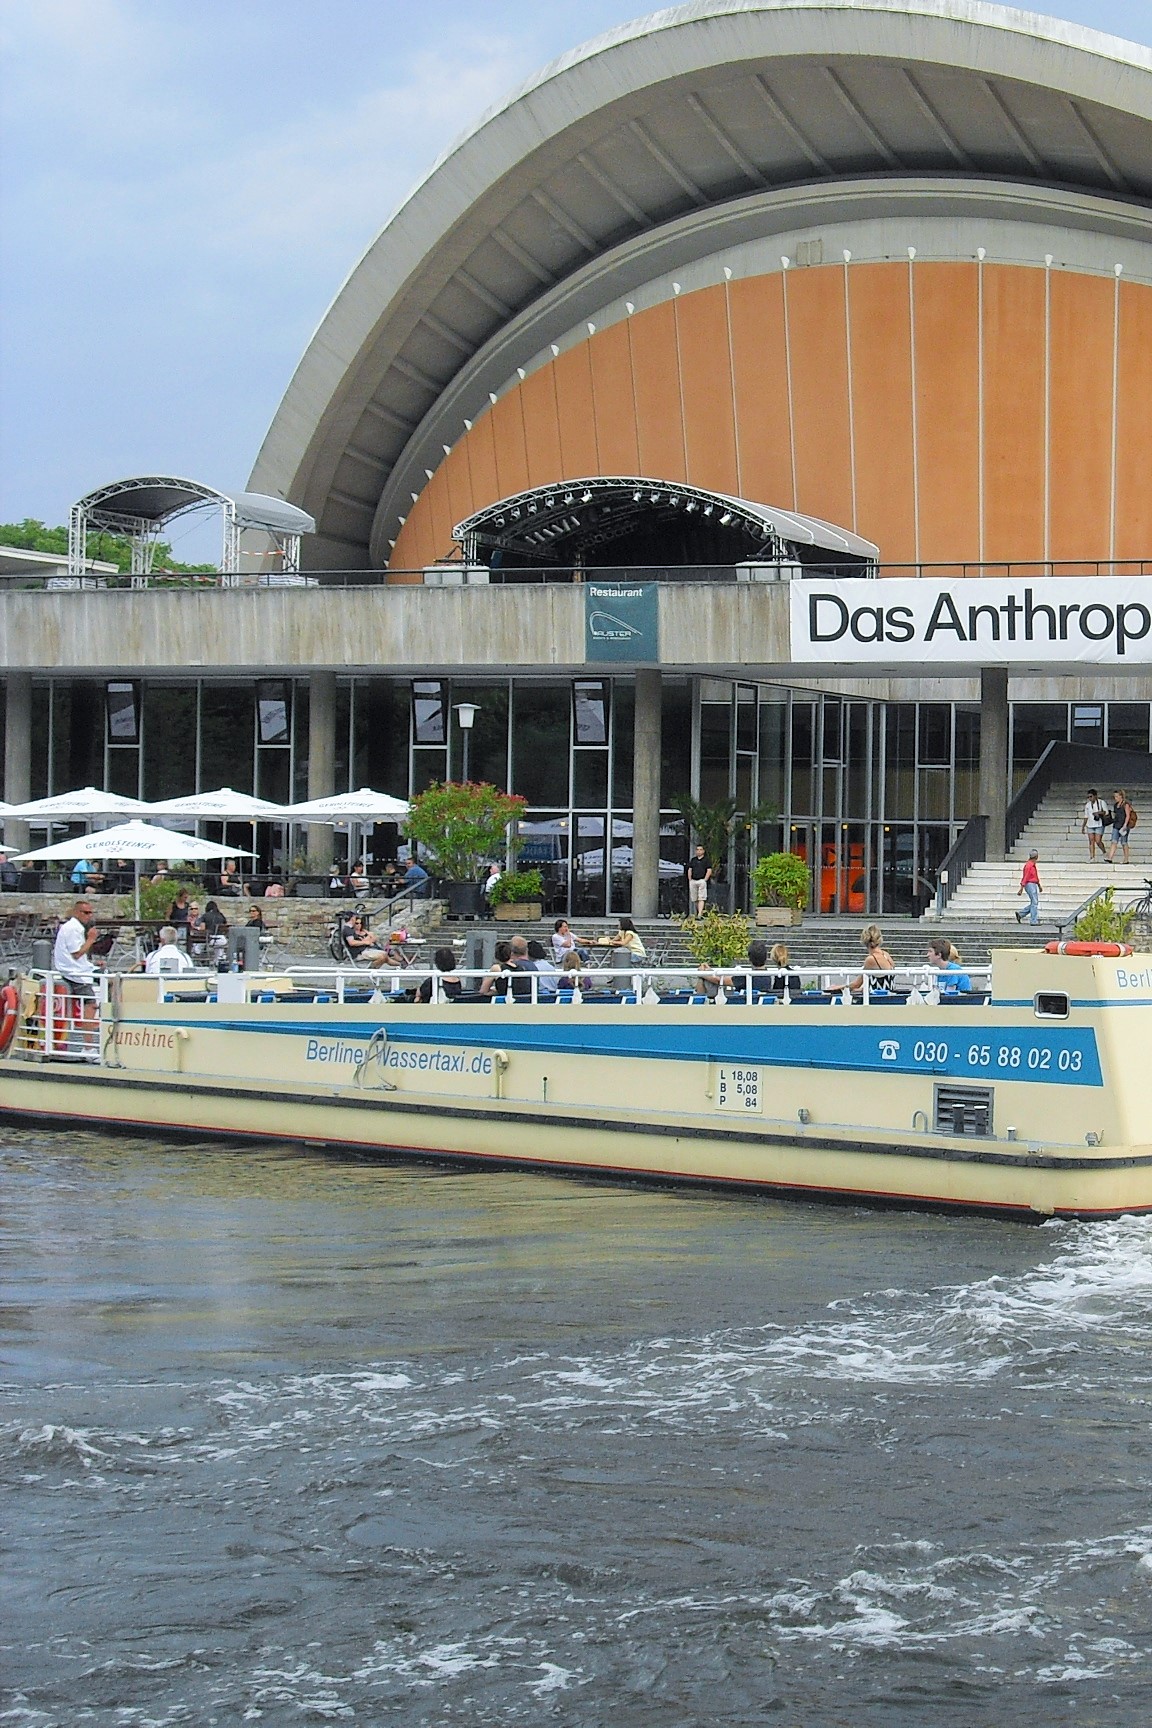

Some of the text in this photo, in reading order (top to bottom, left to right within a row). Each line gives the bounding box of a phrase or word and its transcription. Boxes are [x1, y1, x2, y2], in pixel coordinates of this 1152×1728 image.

[589, 587, 643, 597] Restaurant
[808, 593, 915, 642] Das
[913, 1041, 948, 1063] 030
[968, 1045, 990, 1066] 65
[997, 1046, 1021, 1067] 88
[1028, 1048, 1052, 1069] 02
[1058, 1049, 1082, 1071] 03
[720, 1069, 758, 1083] L 18,08
[720, 1082, 758, 1096] B 5,08
[719, 1095, 757, 1107] P 84
